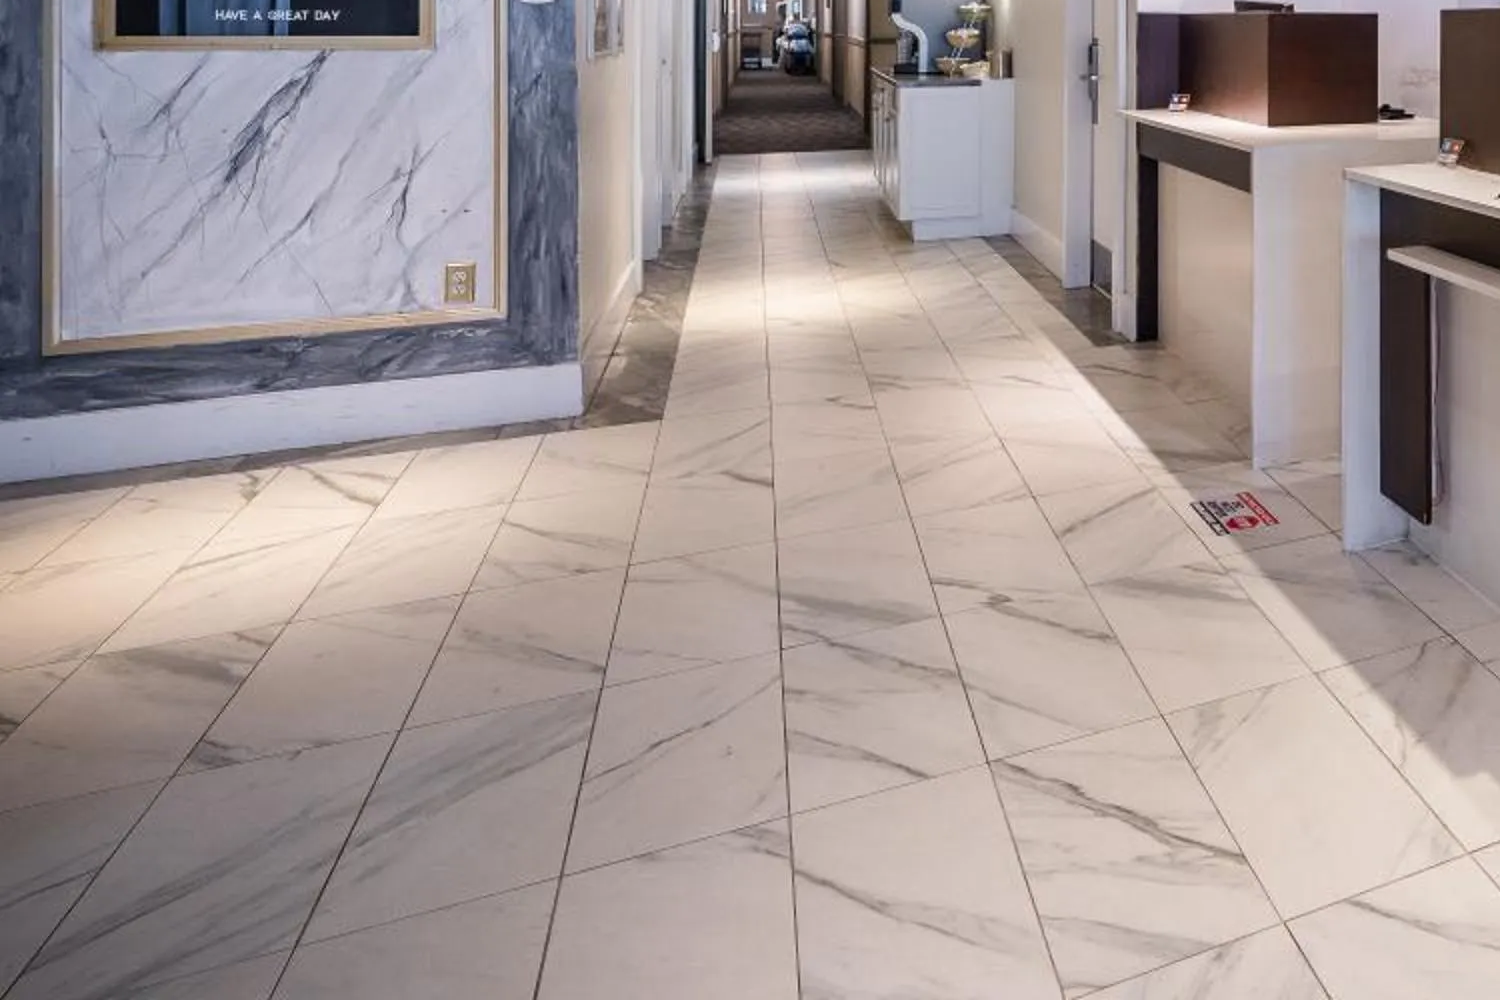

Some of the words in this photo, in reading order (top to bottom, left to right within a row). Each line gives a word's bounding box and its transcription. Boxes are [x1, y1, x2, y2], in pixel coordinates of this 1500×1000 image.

[215, 9, 248, 21] HAVE
[253, 9, 263, 20] A
[267, 9, 309, 21] GREAT
[314, 9, 341, 21] DAY
